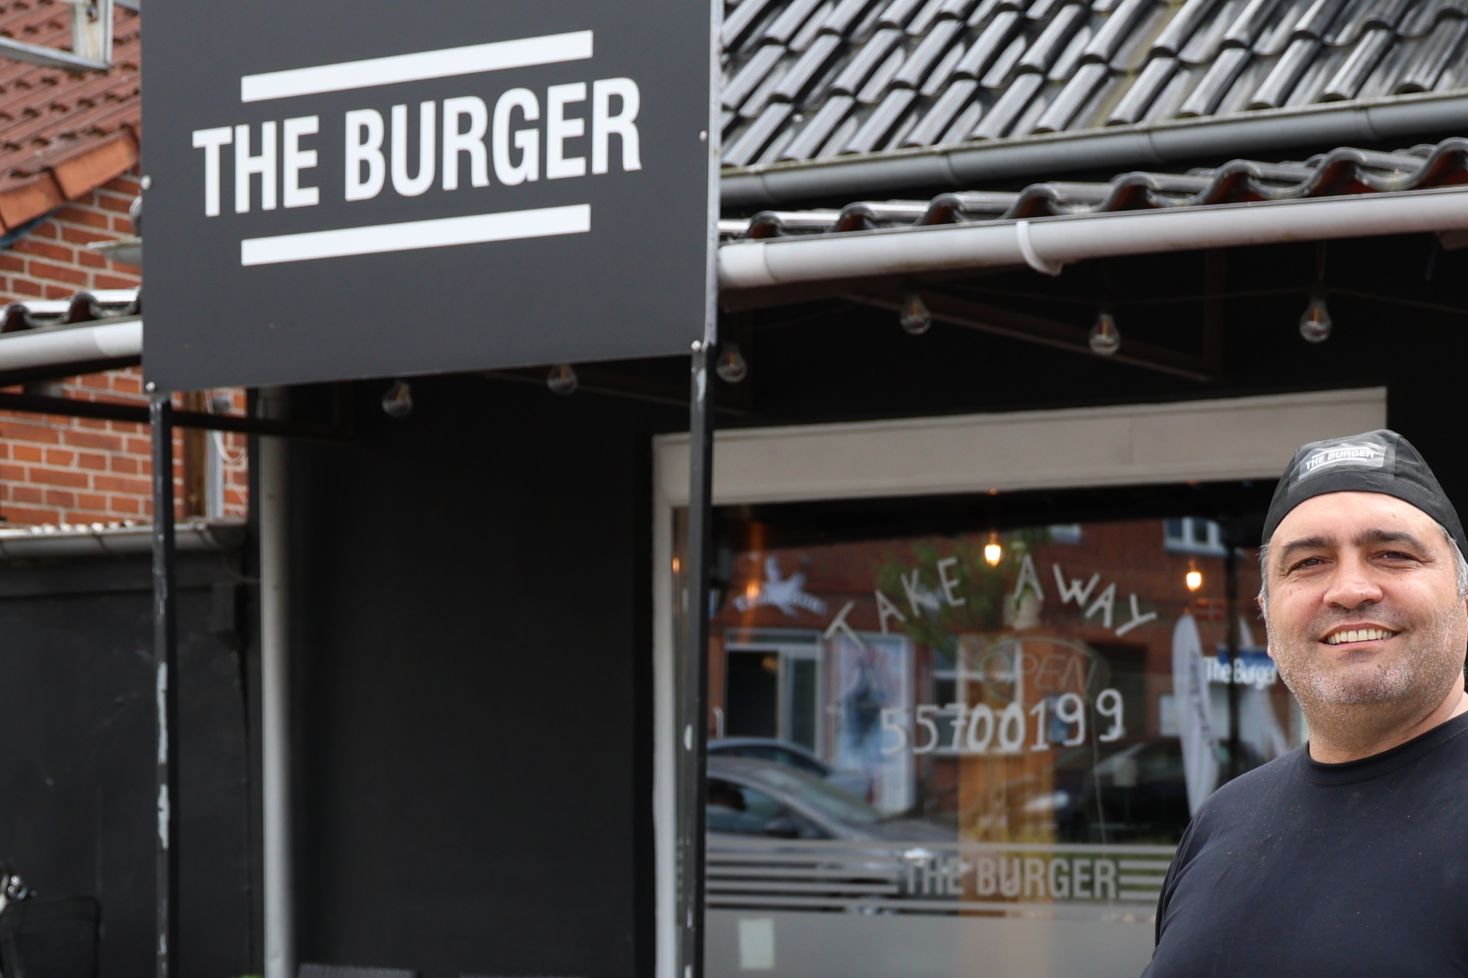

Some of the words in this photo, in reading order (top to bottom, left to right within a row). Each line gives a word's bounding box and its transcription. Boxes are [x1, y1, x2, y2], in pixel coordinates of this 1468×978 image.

[192, 115, 320, 218] THE
[345, 77, 642, 202] BURGER
[1306, 455, 1325, 470] THE
[1327, 448, 1375, 461] BURGER
[822, 556, 967, 648] TAKE
[1013, 553, 1157, 637] AWAY
[980, 651, 1098, 697] OPEN
[1202, 656, 1232, 684] The
[879, 688, 1126, 754] 55700199
[906, 858, 965, 896] THE
[975, 858, 1118, 899] BURGER
